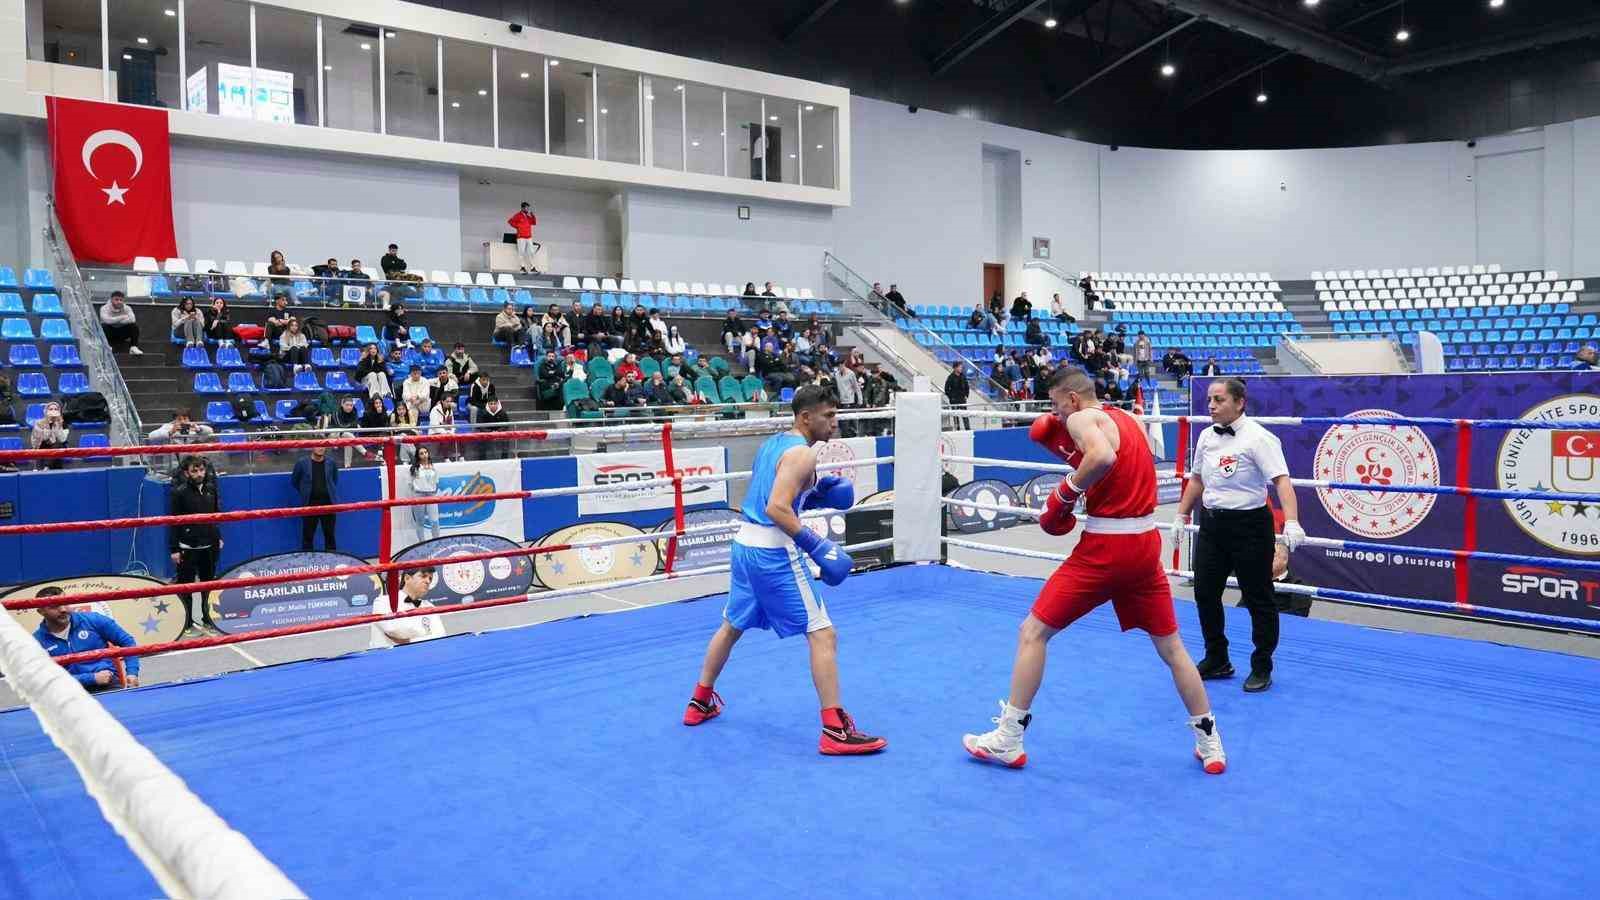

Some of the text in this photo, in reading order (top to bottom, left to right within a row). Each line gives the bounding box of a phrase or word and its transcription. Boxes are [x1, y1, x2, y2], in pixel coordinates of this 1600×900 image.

[1503, 403, 1600, 527] TÜRYE ÜNİVEİTE SPO
[1561, 531, 1599, 546] 1996
[1325, 549, 1353, 559] tusfed
[244, 581, 348, 600] BAŞARILAR DİLERİM
